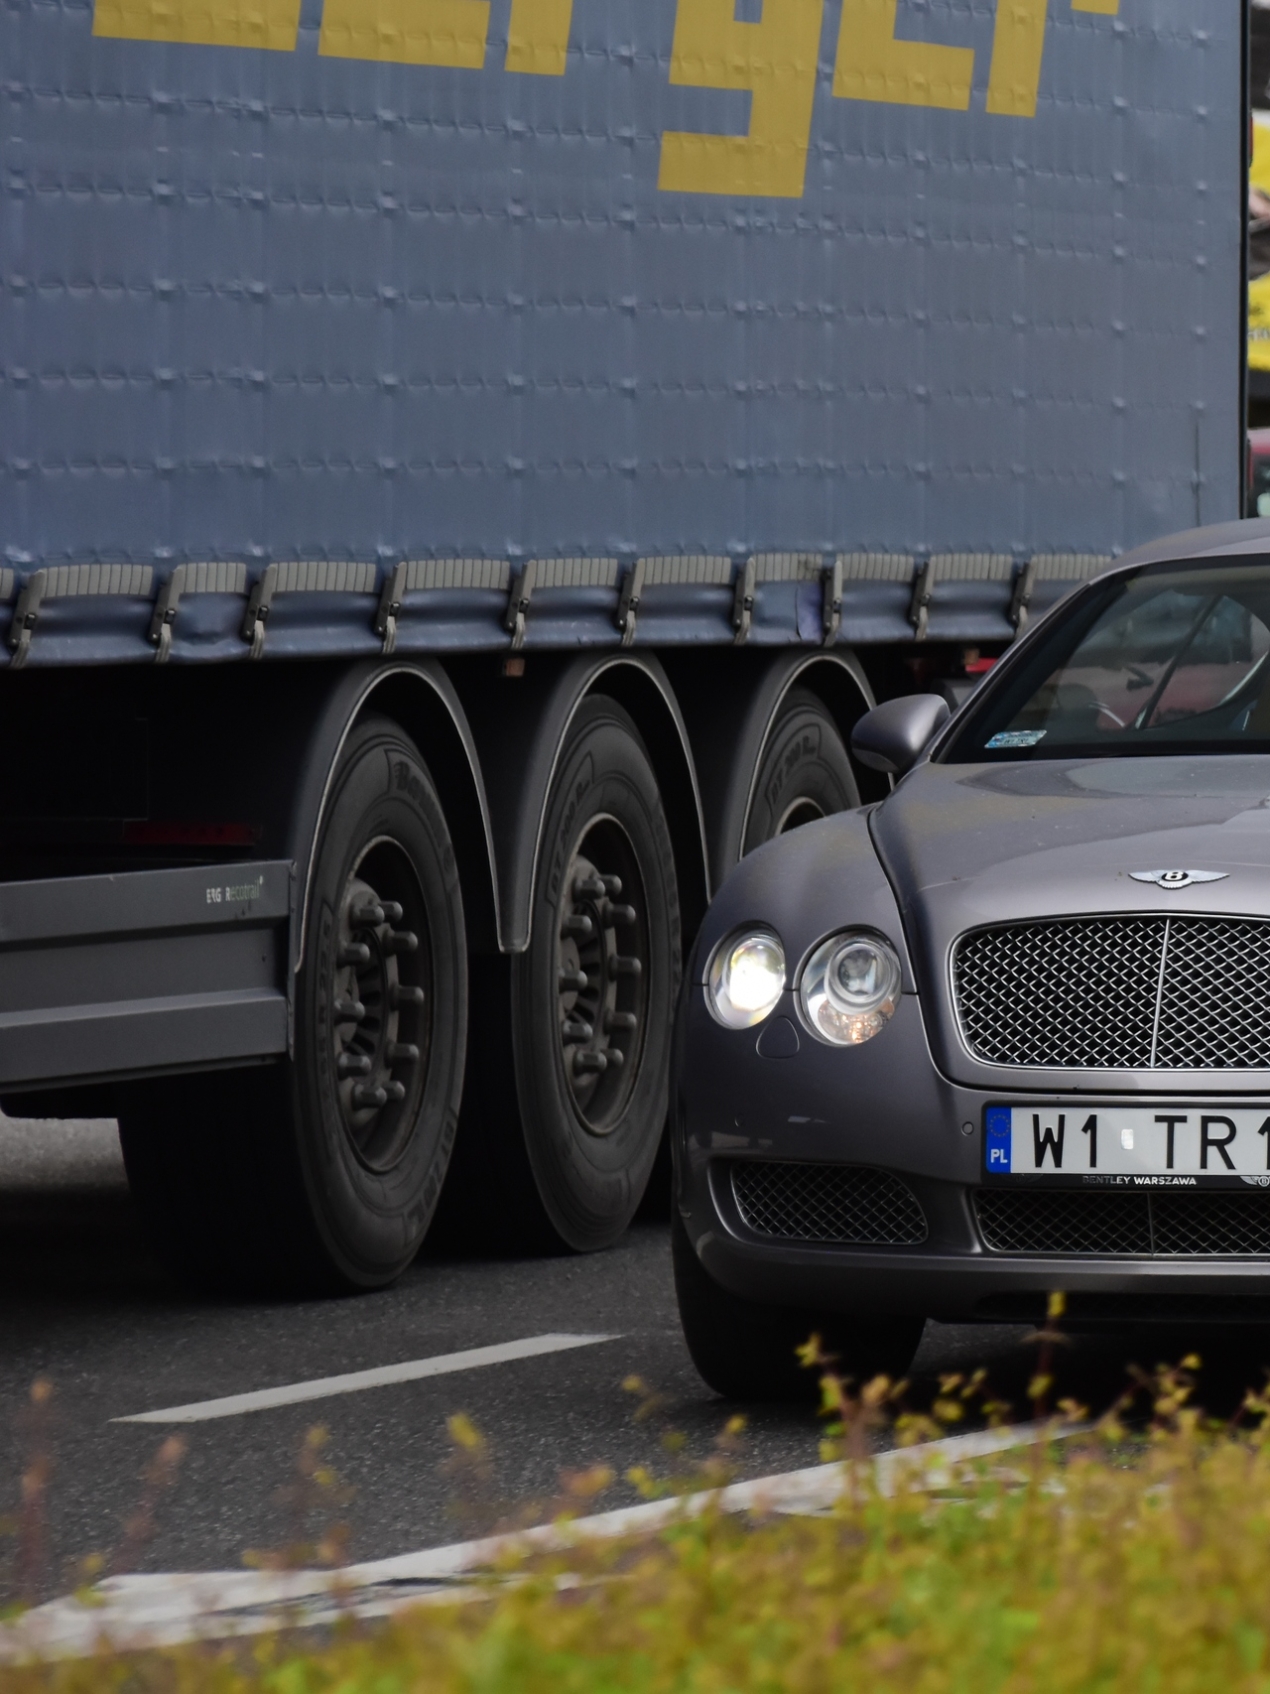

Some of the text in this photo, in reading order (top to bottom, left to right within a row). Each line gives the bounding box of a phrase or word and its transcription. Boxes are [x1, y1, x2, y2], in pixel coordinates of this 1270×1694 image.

[990, 1148, 1008, 1164] PL
[1032, 1113, 1098, 1168] W1
[1082, 1175, 1132, 1185] BENTLEY
[1133, 1176, 1197, 1186] WARSZAWA
